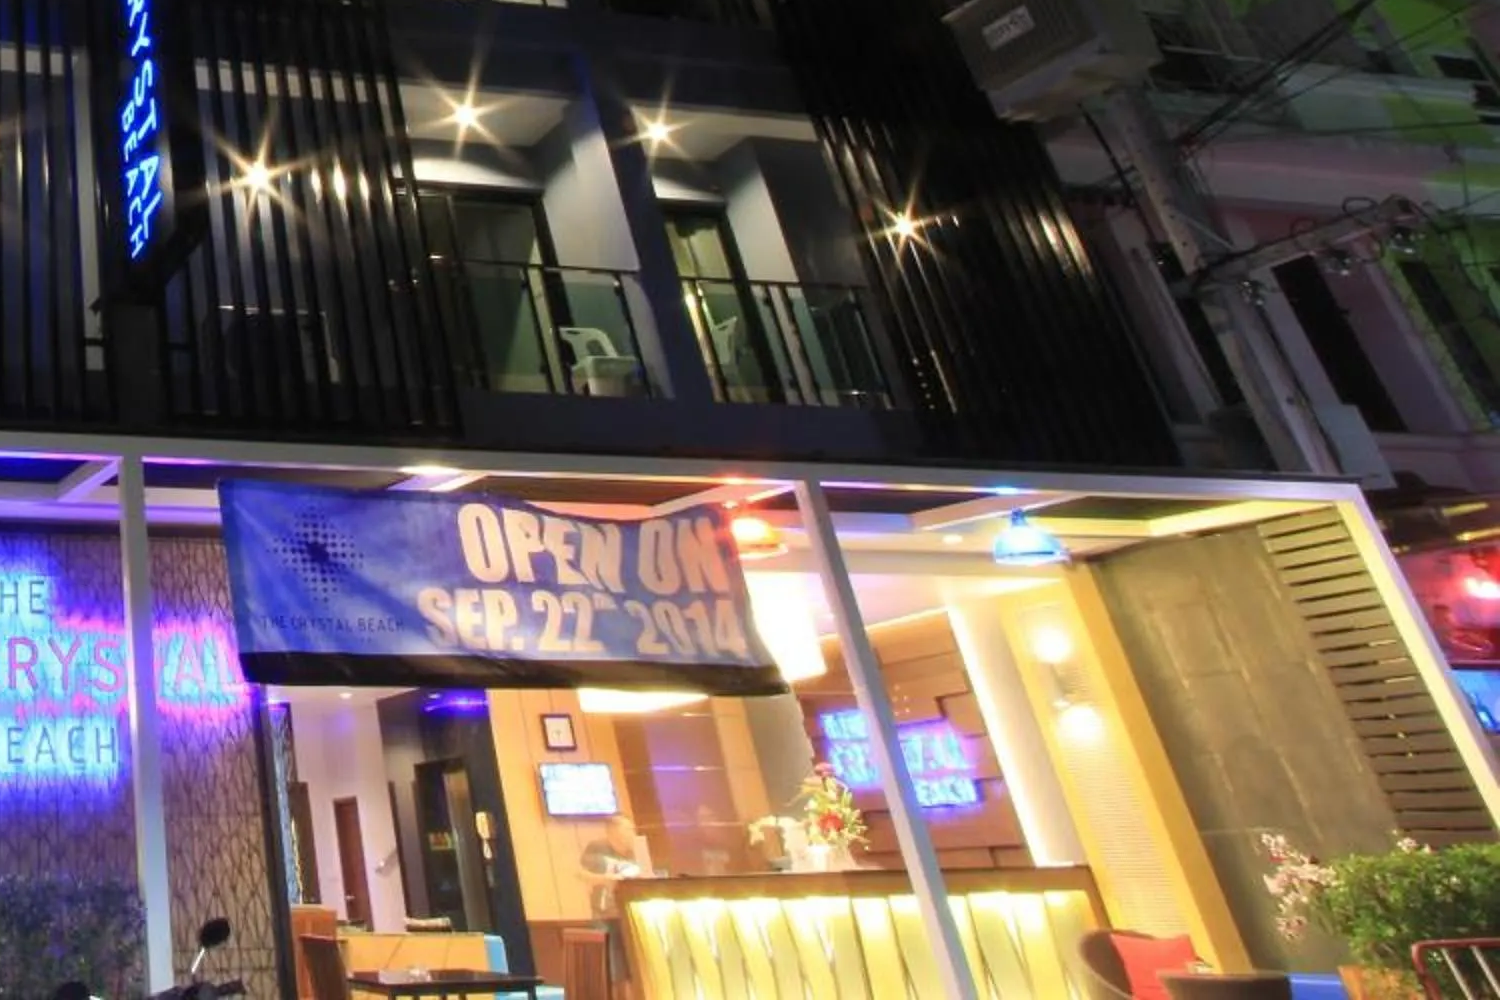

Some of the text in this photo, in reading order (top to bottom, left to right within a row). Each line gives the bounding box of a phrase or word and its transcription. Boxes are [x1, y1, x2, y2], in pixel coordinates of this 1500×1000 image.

[122, 100, 144, 258] BEACH
[457, 503, 730, 594] OPEN ON
[262, 615, 405, 633] THE CRYSTAL BEACH
[417, 586, 524, 650] SEP.
[624, 600, 747, 658] 2014
